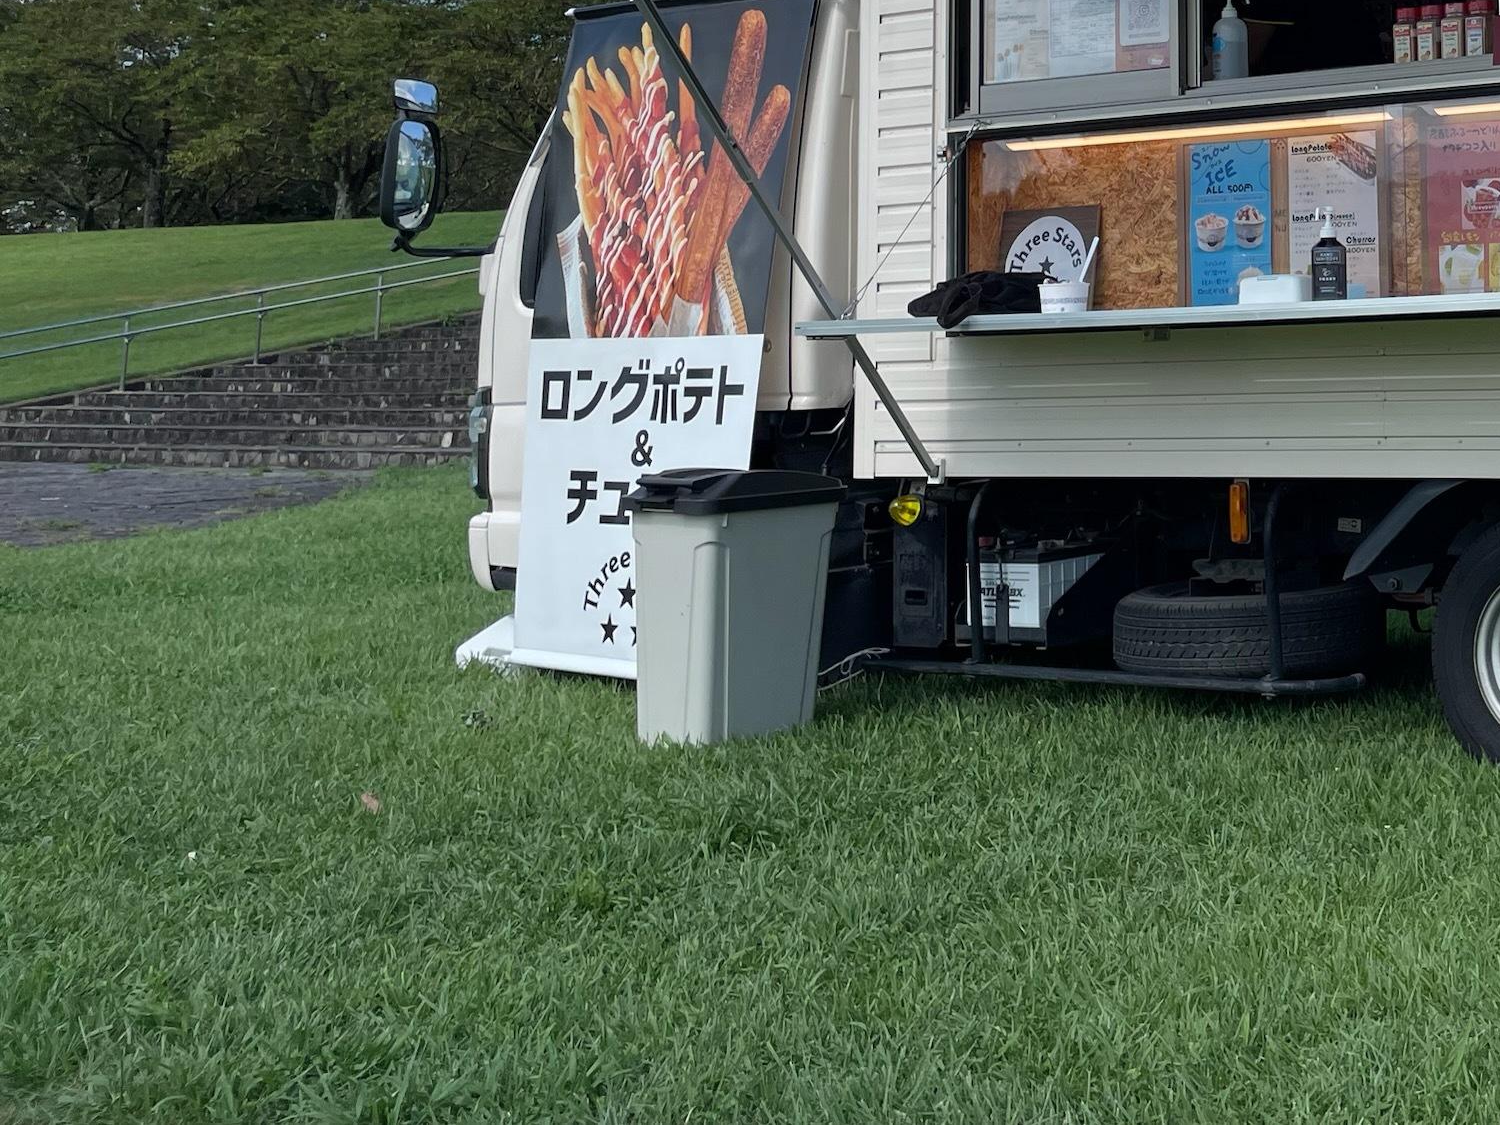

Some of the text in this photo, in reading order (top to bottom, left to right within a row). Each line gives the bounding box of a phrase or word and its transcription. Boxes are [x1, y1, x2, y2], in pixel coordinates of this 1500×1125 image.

[1191, 144, 1230, 170] Snow
[1205, 159, 1237, 186] ICE
[1206, 184, 1254, 194] ALL 500円
[1010, 227, 1082, 273] Three Stars
[1346, 236, 1376, 244] Churros
[540, 357, 745, 426] ロングポテト
[630, 429, 653, 467] &
[583, 550, 632, 612] Three
